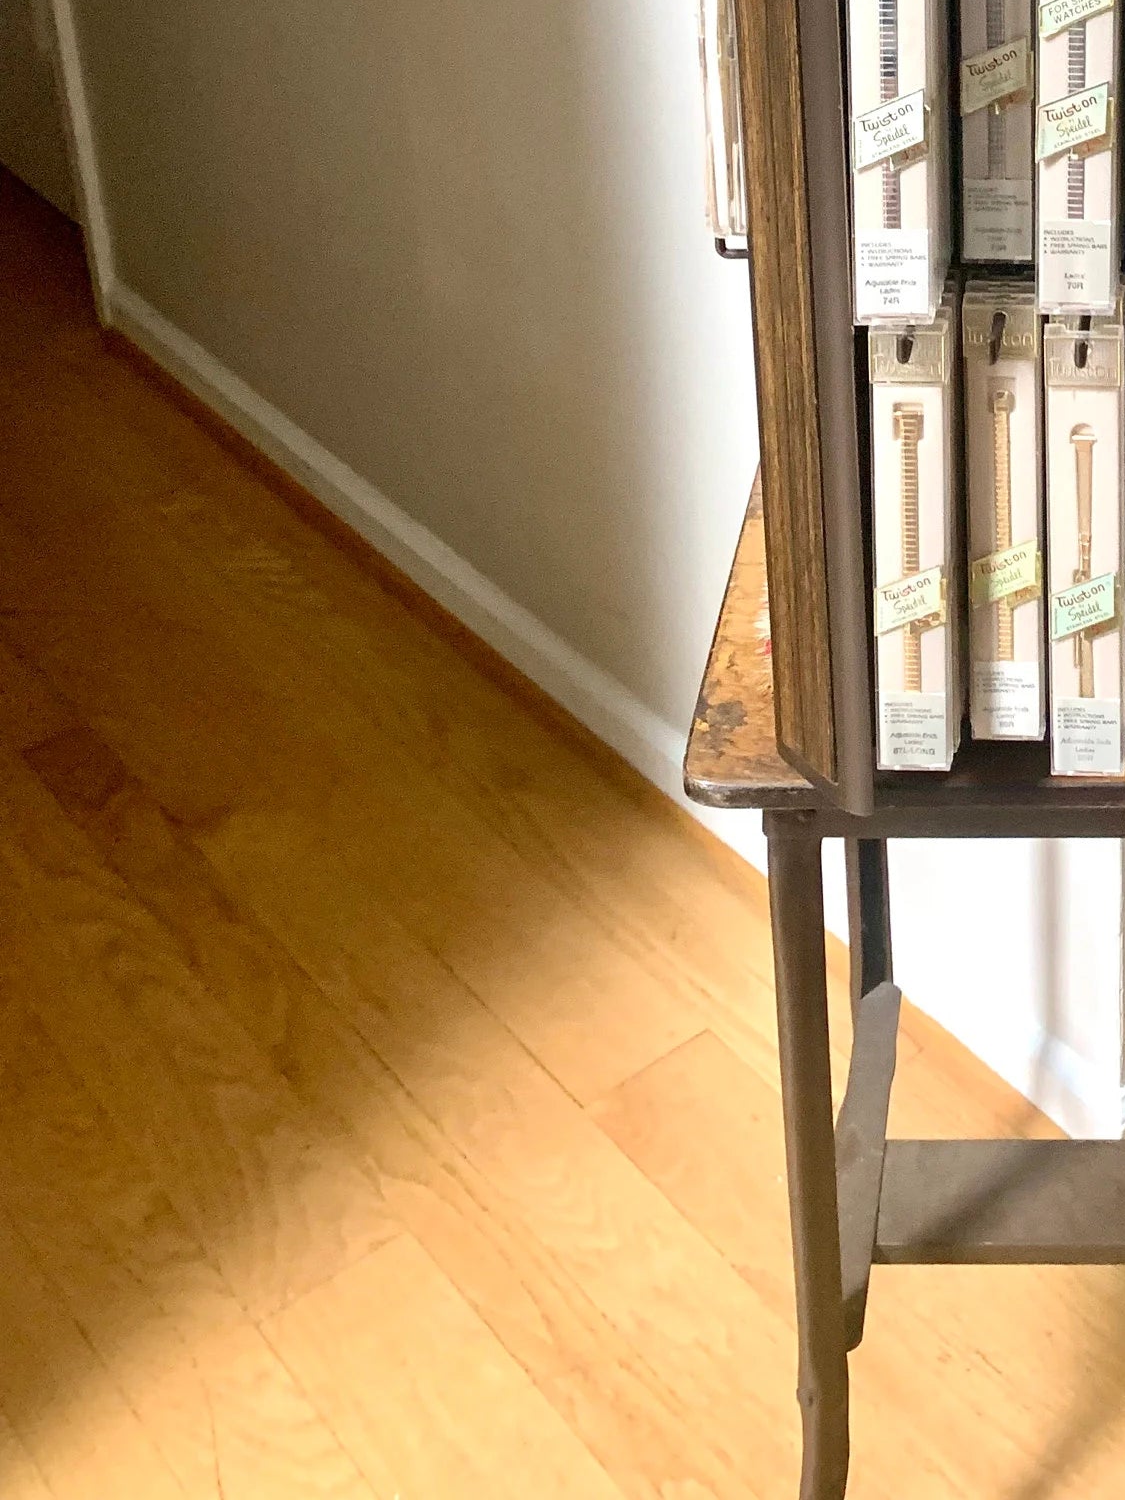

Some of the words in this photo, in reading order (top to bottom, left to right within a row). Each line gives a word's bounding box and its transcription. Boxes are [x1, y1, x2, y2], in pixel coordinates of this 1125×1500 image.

[1048, 0, 1069, 16] FOR
[872, 124, 911, 148] Speidel
[1055, 114, 1094, 139] Speidel
[1067, 602, 1103, 623] Speidel
